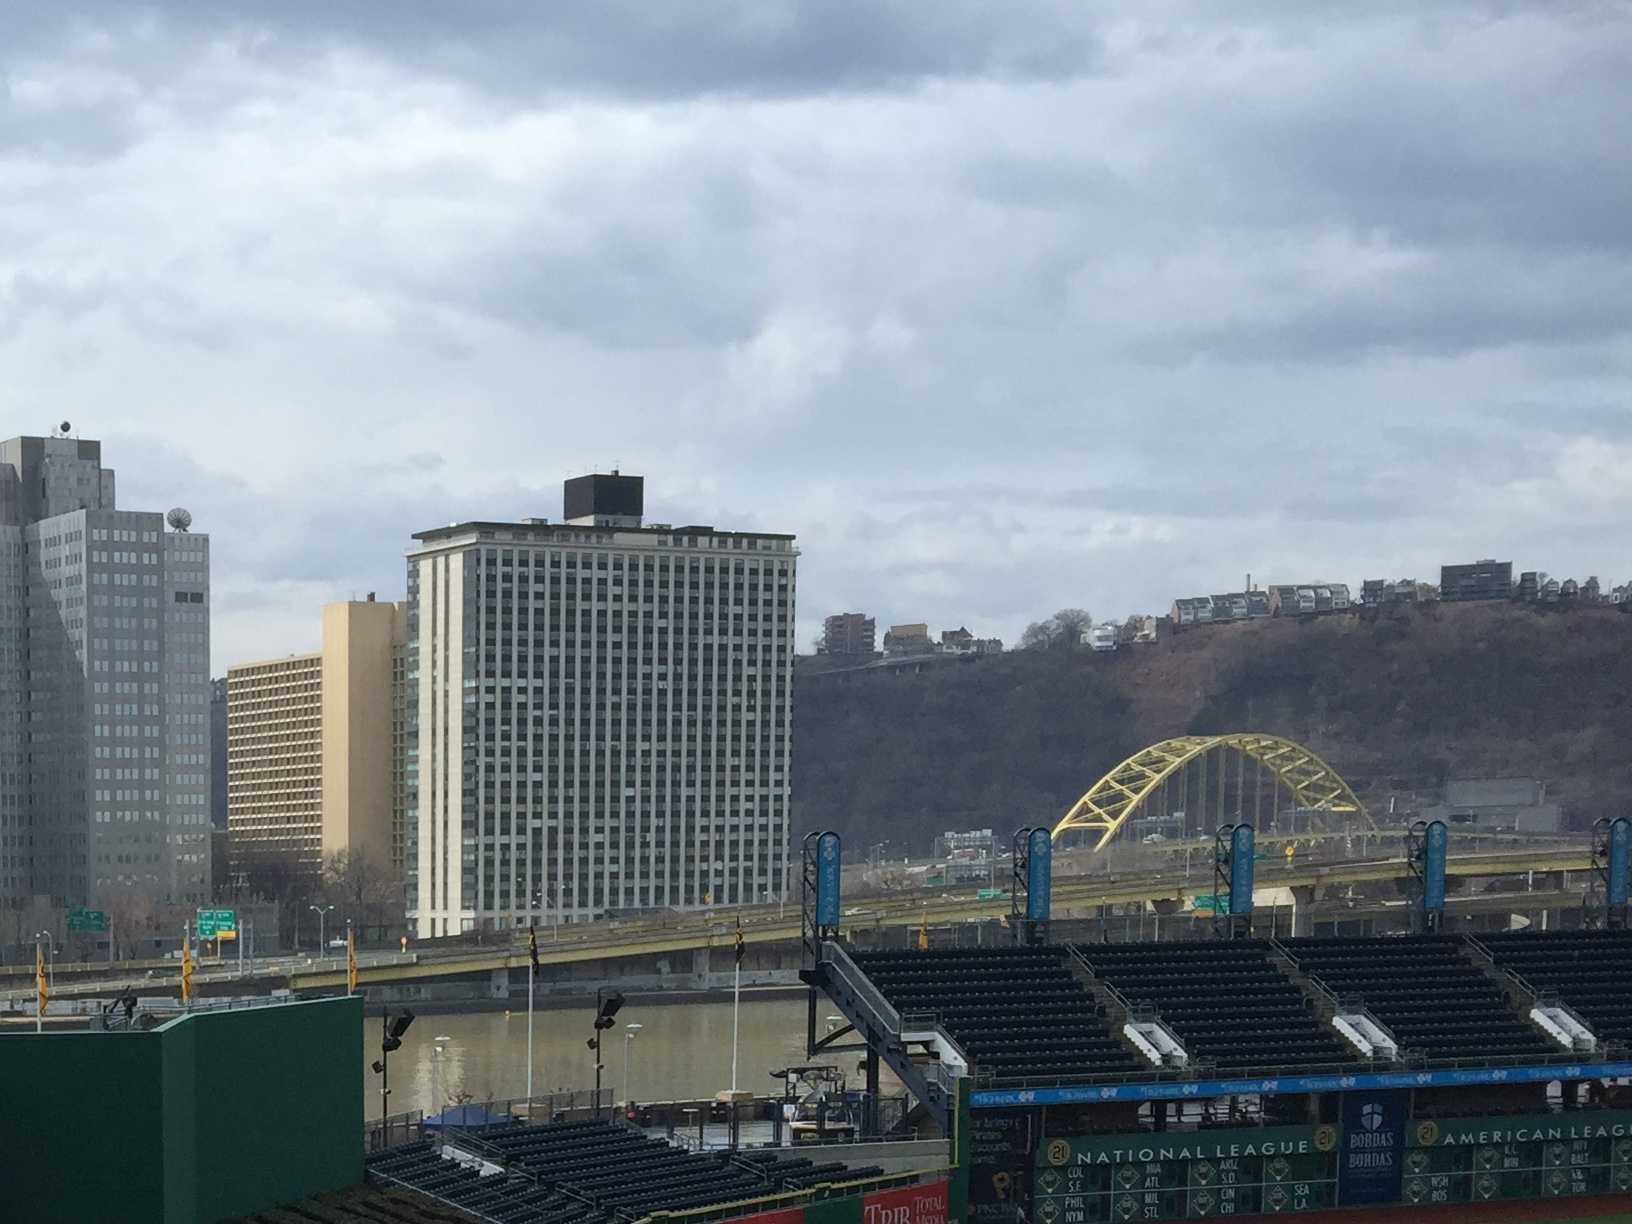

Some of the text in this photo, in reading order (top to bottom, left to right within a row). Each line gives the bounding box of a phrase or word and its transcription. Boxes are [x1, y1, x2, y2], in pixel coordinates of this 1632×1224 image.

[1350, 1132, 1394, 1149] BORDAS
[1443, 1127, 1561, 1145] AMERICAN
[1077, 1140, 1309, 1165] NATIONAL LEAGUE
[1348, 1151, 1393, 1168] BORDAS
[1067, 1167, 1084, 1179] COL
[1144, 1177, 1161, 1189] ATL
[1220, 1187, 1236, 1200] CIN
[1293, 1184, 1310, 1197] SEA
[1431, 1189, 1448, 1202] BOS
[915, 1195, 945, 1215] TOTAL
[1064, 1197, 1085, 1209] PHIL
[1219, 1201, 1235, 1214] CHI
[1065, 1210, 1084, 1223] NYM
[1144, 1206, 1160, 1219] STL
